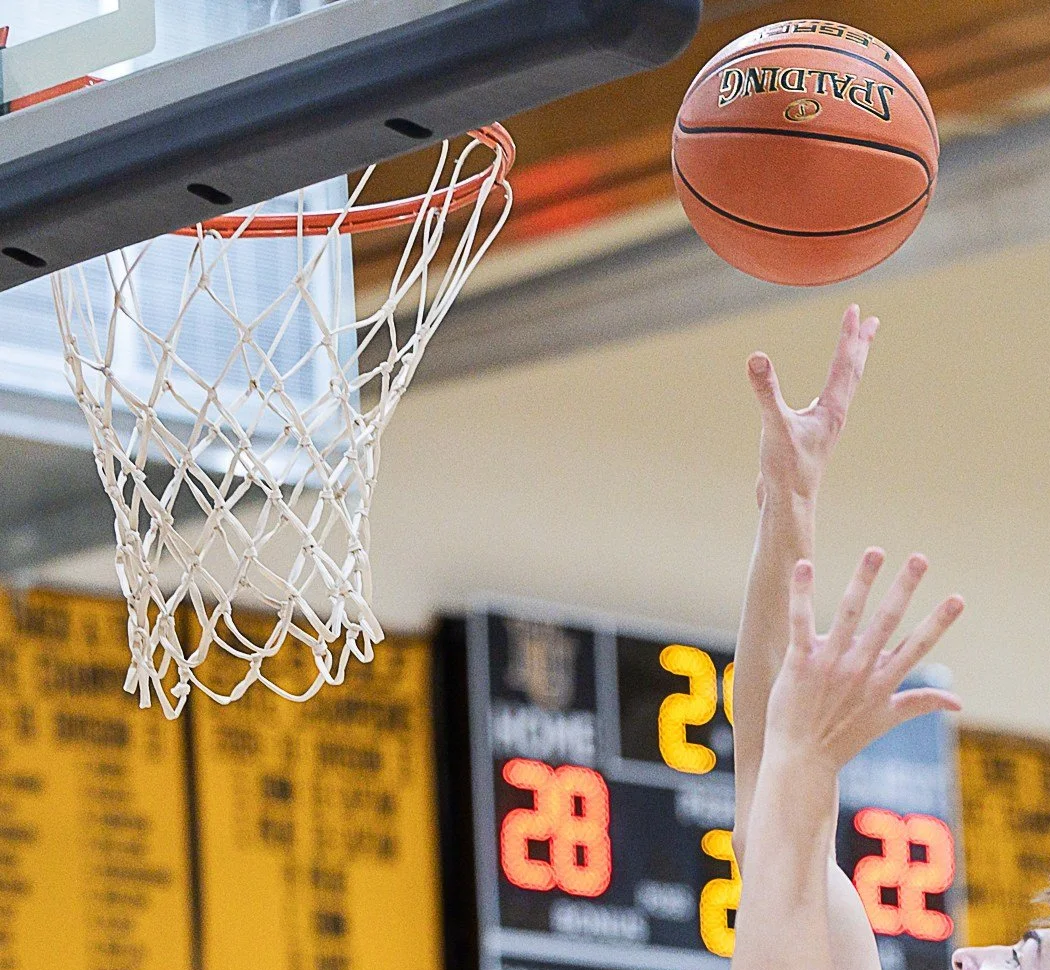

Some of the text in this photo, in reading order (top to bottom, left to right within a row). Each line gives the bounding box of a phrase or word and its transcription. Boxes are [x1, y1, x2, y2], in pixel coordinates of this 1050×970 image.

[718, 66, 895, 122] SPALDING
[658, 644, 735, 774] 2
[501, 757, 614, 898] 28
[852, 806, 957, 942] 22
